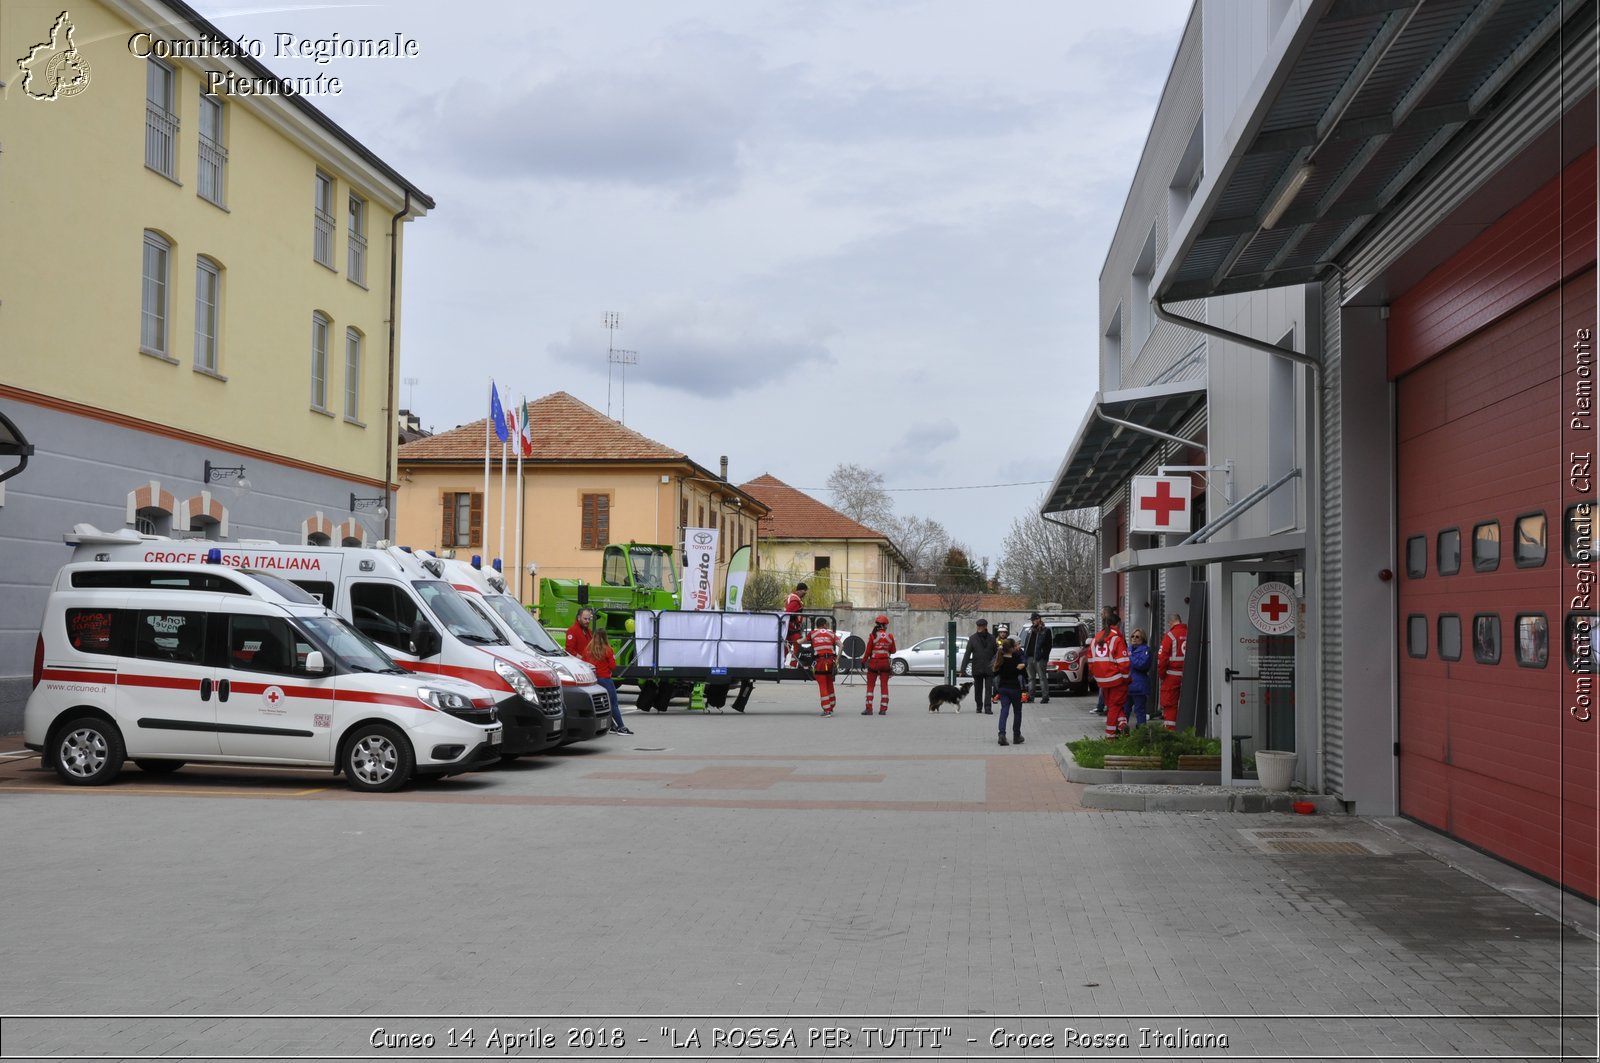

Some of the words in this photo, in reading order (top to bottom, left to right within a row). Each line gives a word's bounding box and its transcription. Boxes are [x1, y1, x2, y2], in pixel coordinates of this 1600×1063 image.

[144, 552, 196, 564] CROCE
[200, 554, 252, 568] RSSA
[254, 556, 322, 571] ITALIANA
[46, 684, 108, 694] www.cricuneo.it
